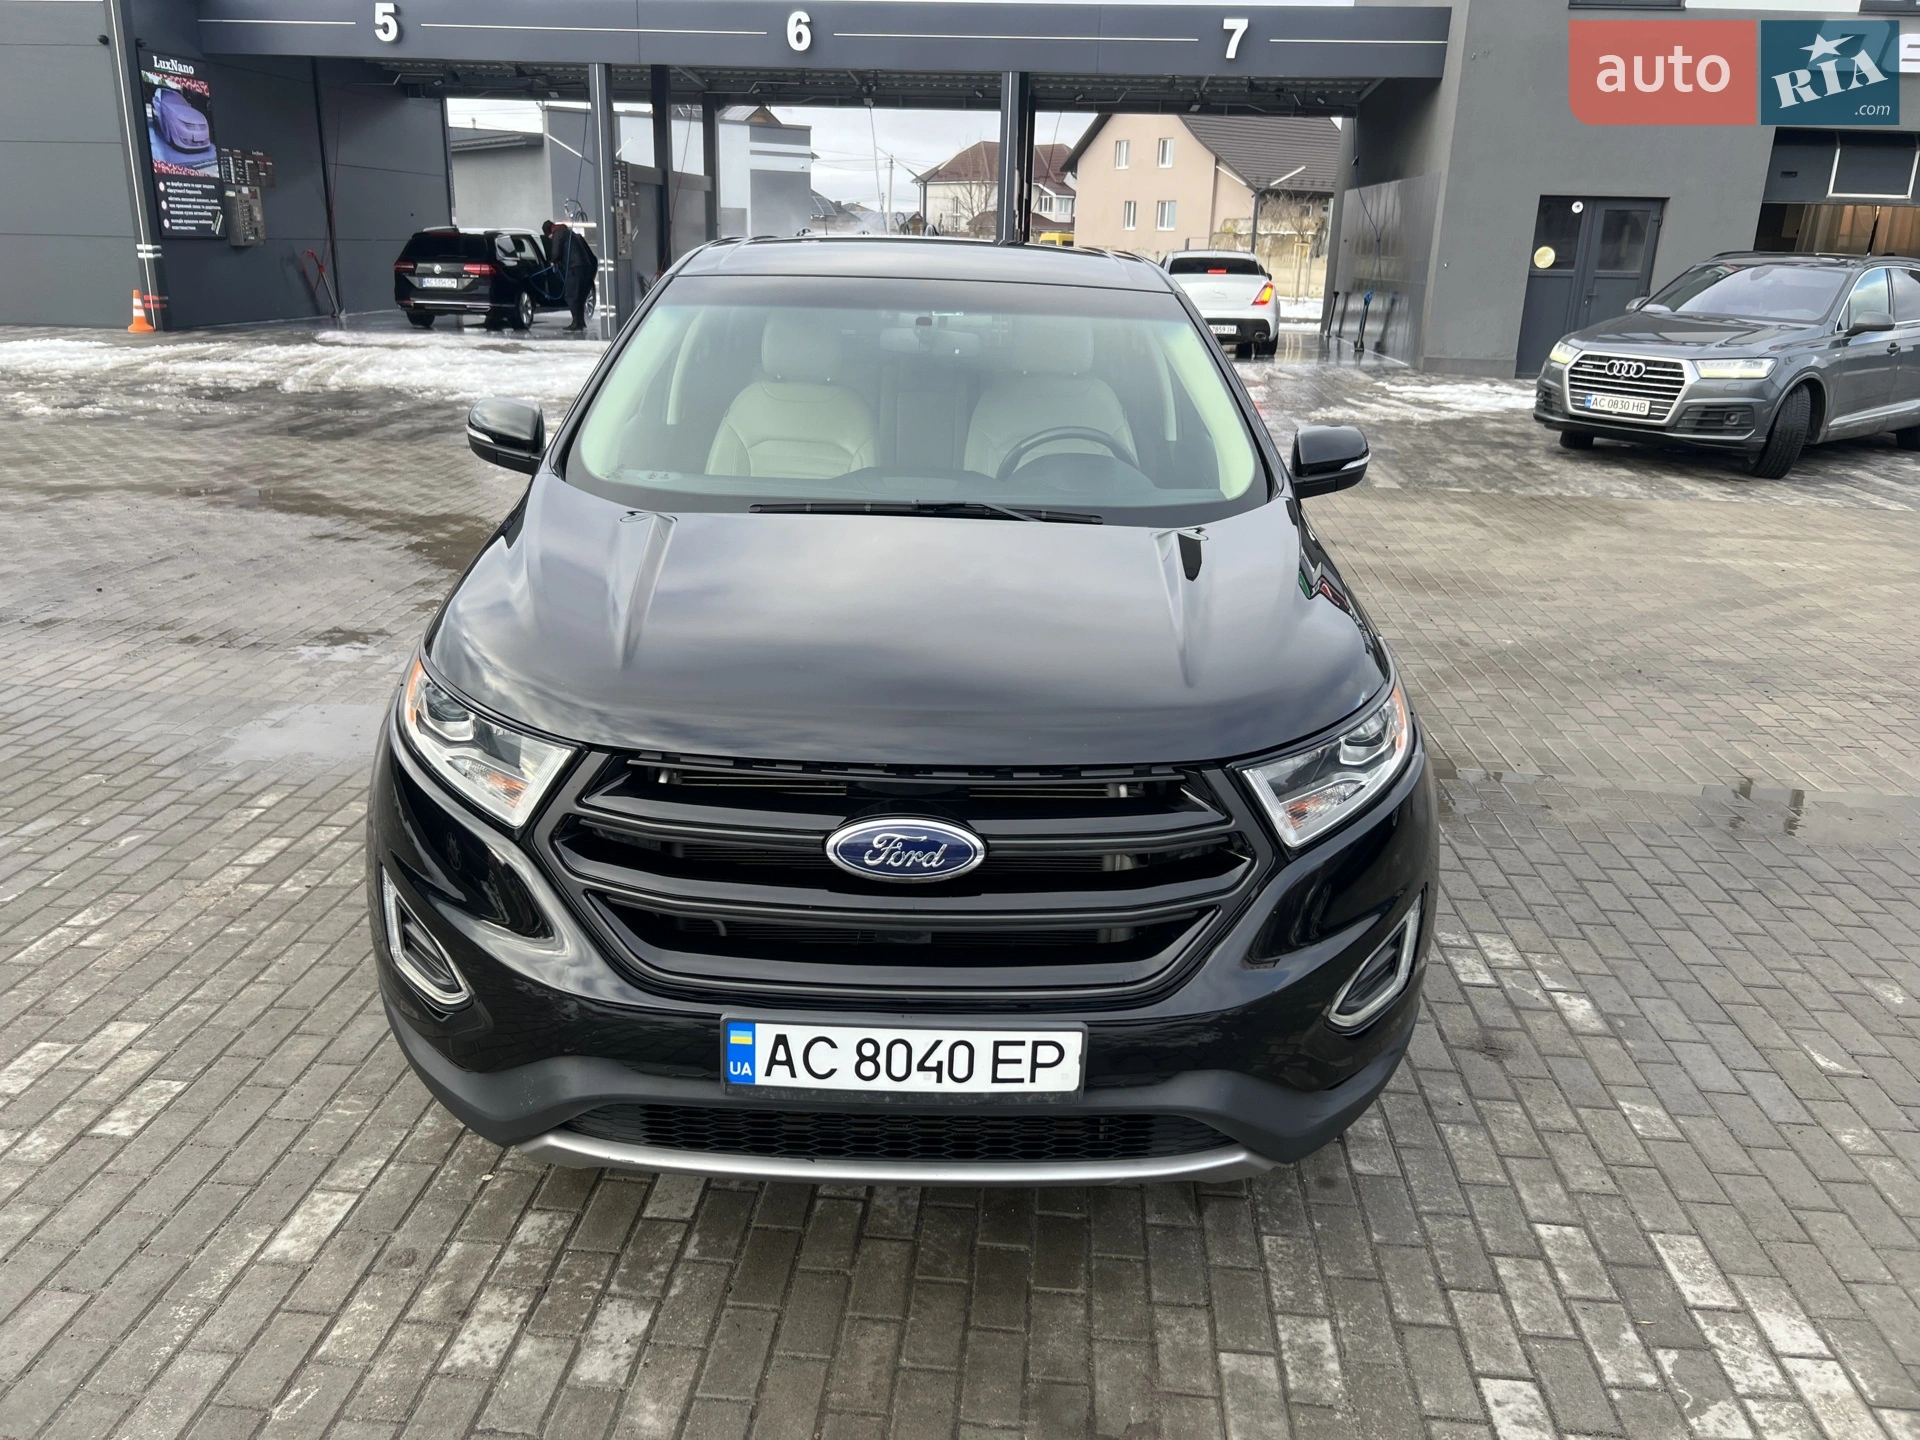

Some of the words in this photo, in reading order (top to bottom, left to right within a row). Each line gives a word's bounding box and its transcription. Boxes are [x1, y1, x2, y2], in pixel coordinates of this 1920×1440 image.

[374, 2, 398, 42] 5
[786, 10, 812, 51] 6
[1223, 18, 1249, 59] 7
[152, 55, 195, 74] LuxNano
[1592, 398, 1606, 408] AC
[1607, 399, 1630, 410] 0830
[1631, 402, 1647, 413] HB
[863, 832, 948, 868] Ford
[729, 1061, 752, 1077] UA
[764, 1033, 838, 1080] AC
[854, 1037, 976, 1084] 8040
[990, 1040, 1066, 1084] EP
